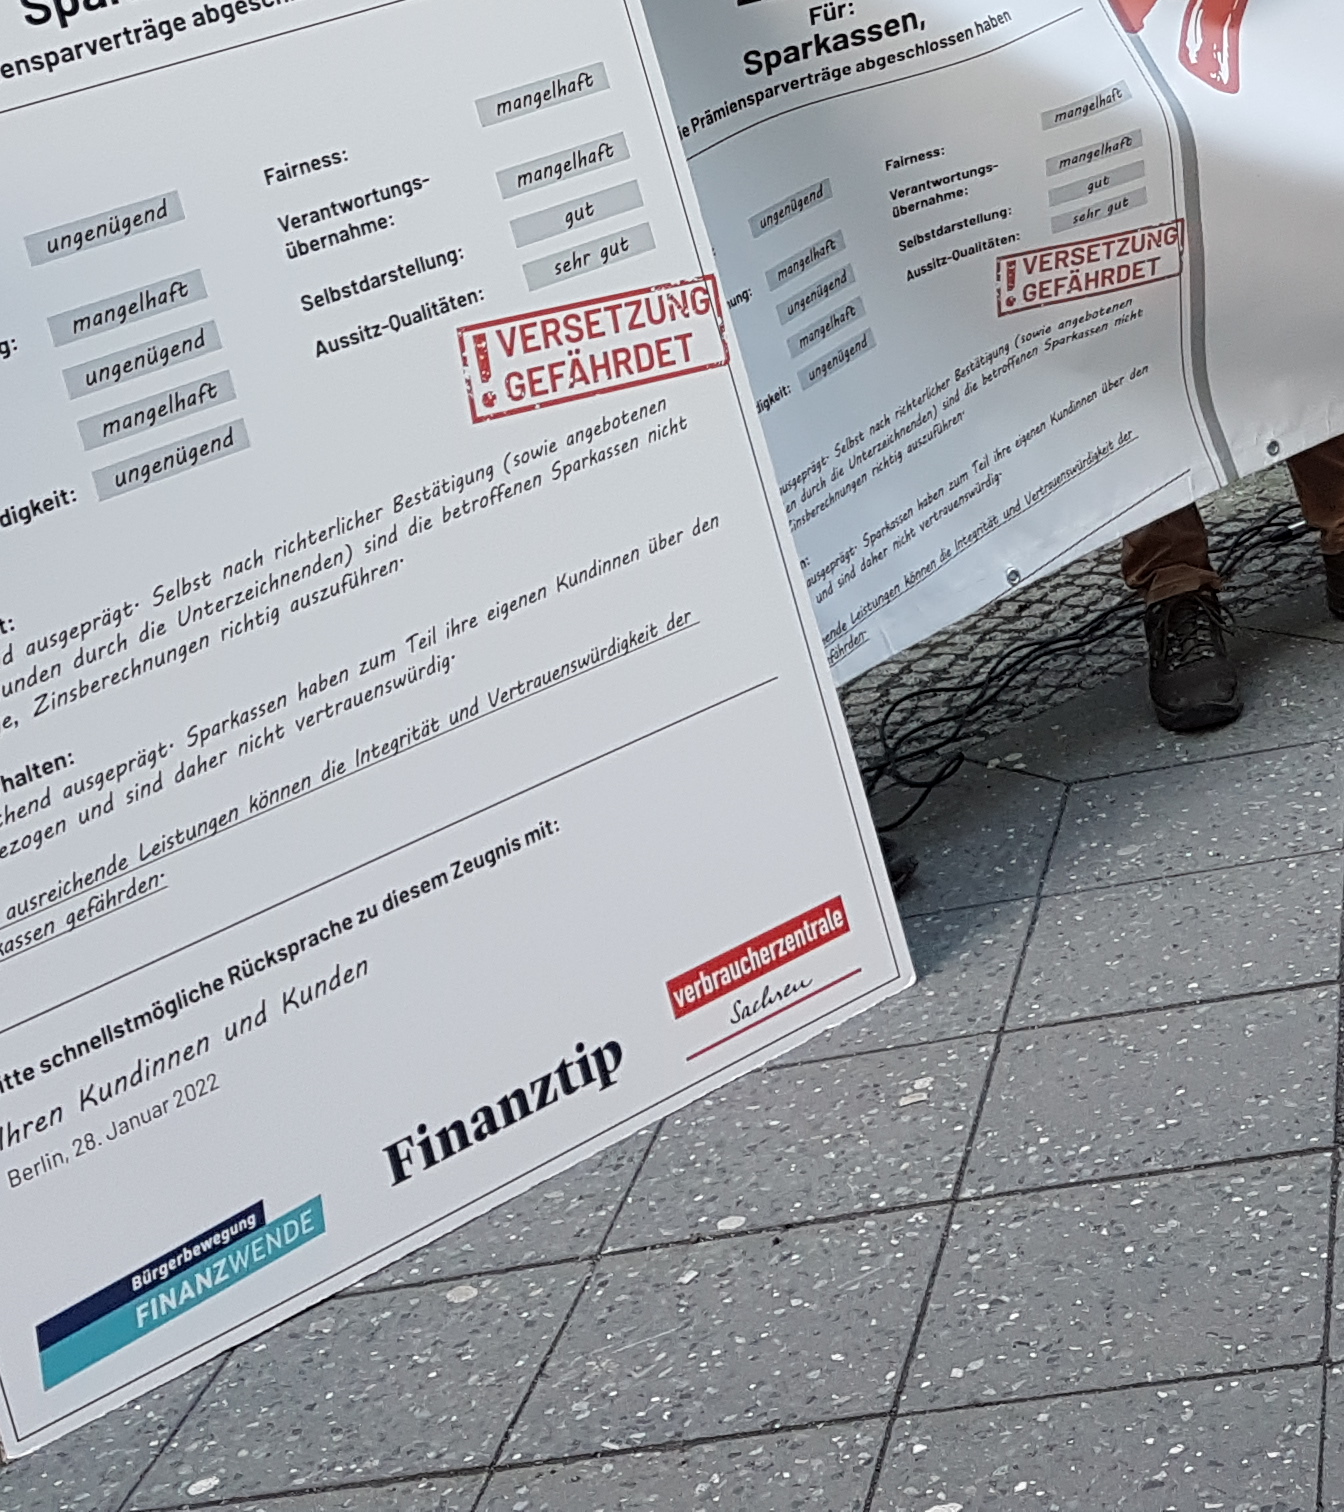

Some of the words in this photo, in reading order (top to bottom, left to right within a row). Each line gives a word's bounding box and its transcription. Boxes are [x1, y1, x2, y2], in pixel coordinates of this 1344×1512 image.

[808, 0, 855, 26] Für:
[743, 11, 926, 76] Sparkassen,
[496, 71, 594, 117] mangelhaft
[690, 64, 851, 134] Prämiensparverträge
[856, 28, 974, 74] abgeschlossen
[975, 9, 1012, 37] haben
[1054, 88, 1122, 123] mangelhaft
[262, 149, 349, 186] Fairness:
[517, 141, 614, 188] mangelhaft
[885, 147, 945, 171] Fairness:
[1059, 136, 1132, 169] mangelhaft
[276, 176, 430, 233] Verantwortungs-
[759, 185, 823, 229] ungenügend
[890, 163, 998, 201] Verantwortungs-
[892, 188, 969, 218] übernahme:
[1087, 176, 1110, 194] gut
[46, 196, 168, 254] ungenügend
[284, 214, 396, 260] übernahme:
[564, 201, 595, 230] gut
[899, 207, 1012, 252] Selbstdarstellung:
[1073, 207, 1100, 225] sehr
[1108, 197, 1129, 216] gut
[554, 250, 591, 276] sehr
[599, 236, 629, 265] gut
[777, 238, 837, 281] mangelhaft
[906, 232, 1020, 281] Aussitz-Qualitäten:
[1023, 227, 1178, 274] VERSETZUNG
[299, 247, 465, 312] Selbstdarstellung:
[787, 272, 847, 315] ungenügend
[1023, 257, 1161, 303] GEFÄHRDET
[72, 280, 189, 335] mangelhaft
[315, 288, 485, 359] Aussitz-Qualitäten:
[495, 287, 711, 357] VERSETZUNG
[799, 306, 856, 349] mangelhaft
[85, 326, 205, 387] ungenügend
[504, 332, 695, 402] GEFÄHRDET
[102, 381, 218, 438] mangelhaft
[114, 425, 234, 488] ungenügend
[151, 570, 212, 608] Selbst
[222, 548, 264, 580] nach
[273, 506, 384, 561] richterlicher
[392, 464, 494, 514] Bestätigung
[502, 438, 559, 475] (sowie
[565, 397, 667, 447] angebotenen
[72, 631, 128, 670] durch
[137, 619, 168, 644] die
[176, 542, 353, 628] Unterzeichnenden)
[363, 522, 398, 555] sind
[407, 514, 434, 537] die
[441, 473, 542, 524] betroffenen
[550, 436, 639, 482] Sparkassen
[647, 415, 688, 444] nicht
[185, 693, 287, 749] Sparkassen
[297, 667, 349, 702] haben
[358, 648, 396, 676] zum
[404, 624, 437, 654] Teil
[445, 615, 479, 640] ihre
[486, 585, 547, 622] eigenen
[555, 547, 640, 593] Kundinnen
[647, 529, 685, 555] über
[691, 515, 719, 537] den
[32, 634, 210, 718] Zinsberechnungen
[220, 604, 280, 642] richtig
[38, 976, 226, 1075] schnellstmögliche
[226, 915, 354, 986] Rücksprache
[355, 903, 379, 925] zu
[381, 870, 449, 913] diesem
[448, 836, 522, 881] Zeugnis
[523, 819, 560, 847] mit:
[673, 907, 845, 1008] verbraucherzentrale
[729, 977, 814, 1025] Sachsen
[79, 1035, 210, 1113] Kundinnen
[224, 998, 268, 1042] und
[281, 958, 368, 1015] Kunden
[6, 1151, 70, 1188] Berlin,
[71, 1132, 103, 1158] 28.
[104, 1098, 170, 1141] Januar
[171, 1072, 220, 1109] 2022
[381, 1039, 623, 1188] Finanztip
[131, 1212, 256, 1291] Bürgerbewegung
[134, 1209, 315, 1328] FINANZWENDE
